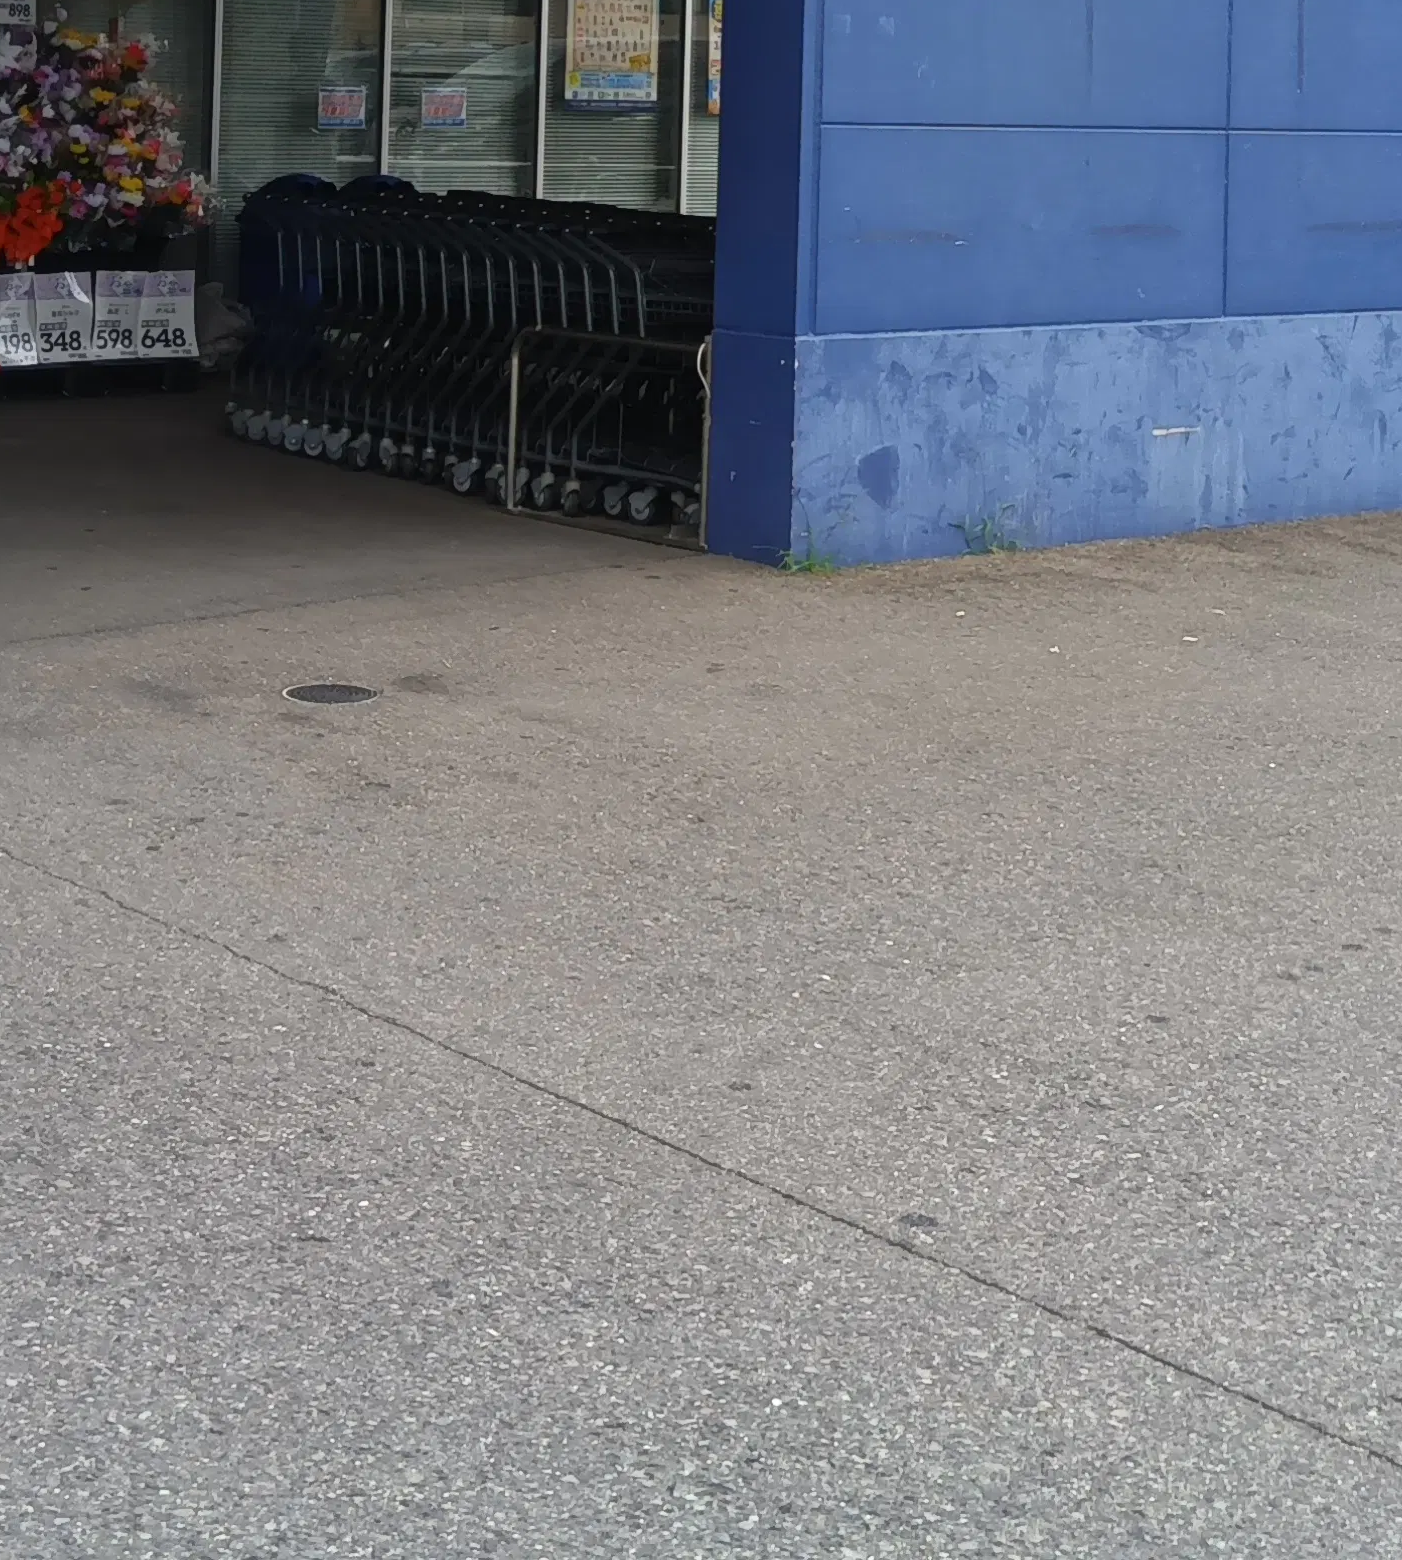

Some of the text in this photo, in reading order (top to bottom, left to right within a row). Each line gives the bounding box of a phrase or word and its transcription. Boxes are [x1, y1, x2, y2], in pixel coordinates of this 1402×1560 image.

[8, 3, 30, 17] 898
[1, 332, 34, 355] 198
[40, 330, 82, 352] 348
[96, 328, 133, 349] 598
[141, 327, 187, 348] 648
